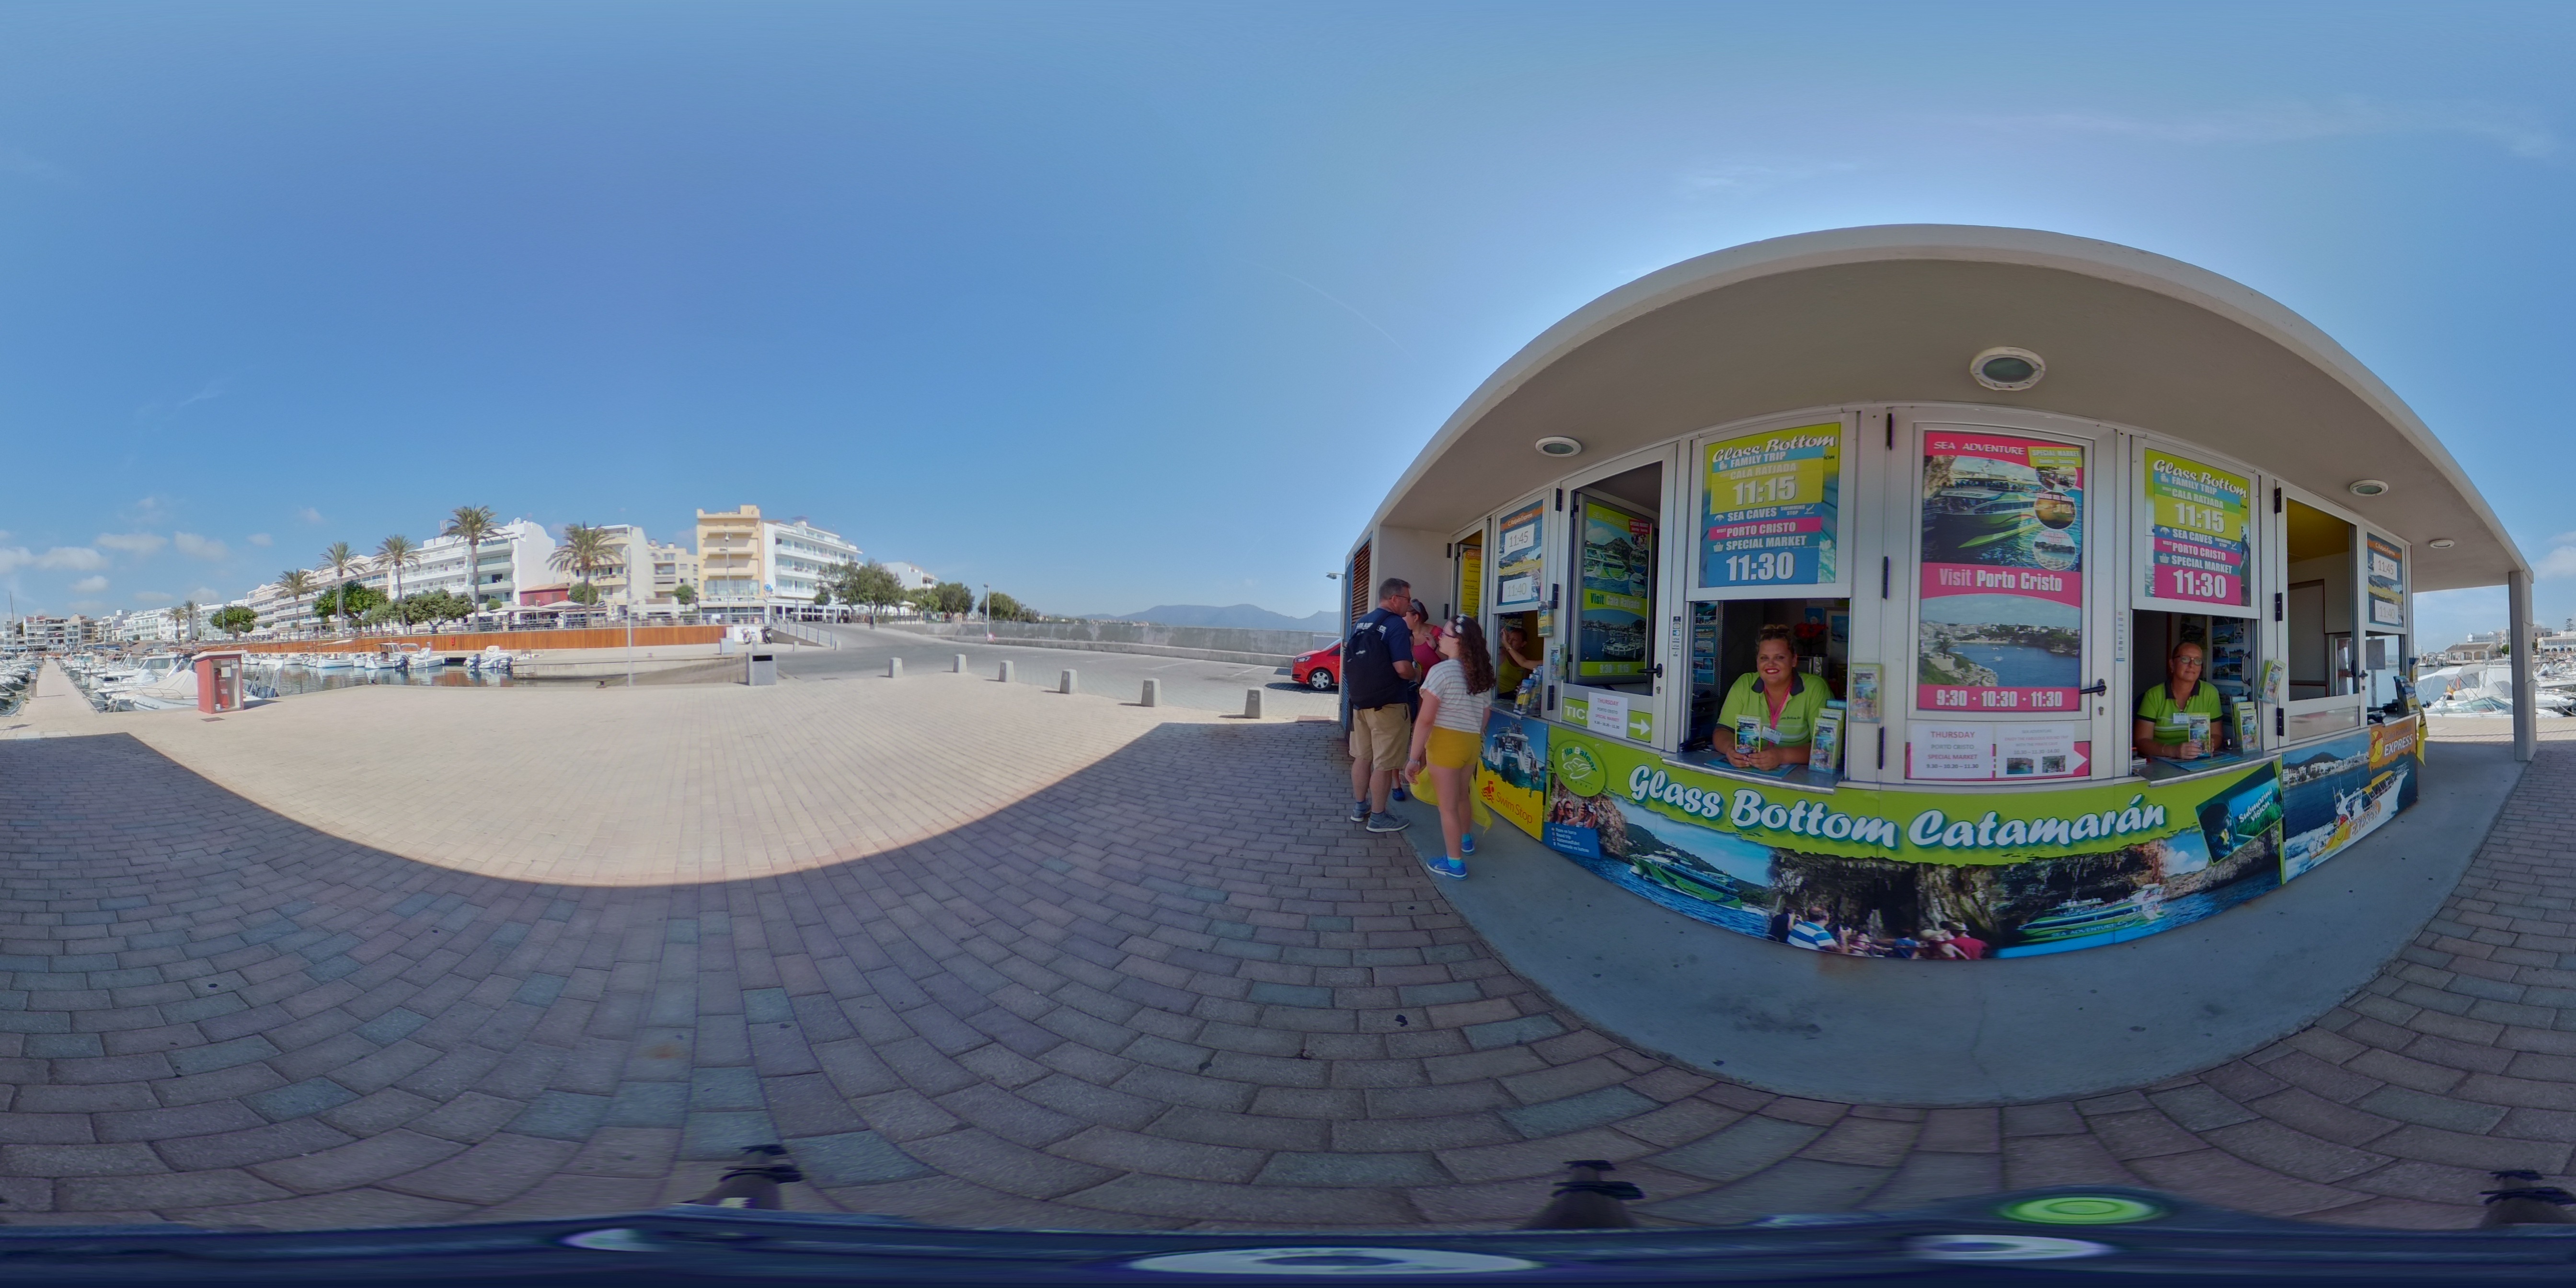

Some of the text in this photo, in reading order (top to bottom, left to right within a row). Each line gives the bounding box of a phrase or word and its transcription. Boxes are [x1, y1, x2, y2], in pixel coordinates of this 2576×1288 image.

[1712, 435, 1836, 462] Glass Bottom
[1933, 441, 2025, 455] SEA ADVENTURE
[1731, 451, 1786, 468] FAMILY TRIP
[1731, 468, 1752, 480] CALA
[2153, 460, 2247, 498] Glass Bottom
[1733, 476, 1796, 506] 11:15
[2172, 476, 2217, 495] FAMILY TRIP
[2172, 488, 2193, 501] CALA
[1727, 507, 1777, 522] SEA CAVES
[2175, 502, 2225, 533] 11:15
[1726, 525, 1757, 537] PORTO
[1759, 522, 1796, 534] CRISTO
[2173, 529, 2213, 545] SEA CAVES
[1509, 530, 1529, 547] 11:45
[1726, 539, 1763, 551] SPECIAL
[1766, 535, 1806, 548] MARKET
[2173, 543, 2198, 556] PORTO
[2200, 547, 2226, 561] CRISTO
[1726, 552, 1794, 581] 11:30
[2172, 555, 2232, 574] SPECIAL MARKET
[2378, 560, 2394, 575] 11:45
[1939, 568, 2062, 592] Visit Porto Cristo
[2173, 569, 2227, 598] 11:30
[1507, 583, 1527, 597] 11:40
[1590, 593, 1604, 605] Visit
[1606, 595, 1619, 607] Cala
[2380, 606, 2395, 619] 11:40
[1599, 664, 1629, 674] 9:30 11:15
[1597, 698, 1619, 706] THURSDAY
[1936, 690, 2063, 707] 9:30 10:30 11:30
[1565, 705, 1588, 720] TIC
[2384, 734, 2413, 757] EXPRESS
[1574, 747, 1597, 772] Balear
[1495, 792, 1532, 824] Swim Stop
[1629, 764, 2167, 850] Glass Bottom Catamarán
[2251, 801, 2270, 822] vision
[2070, 923, 2116, 935] ADVENTURE
